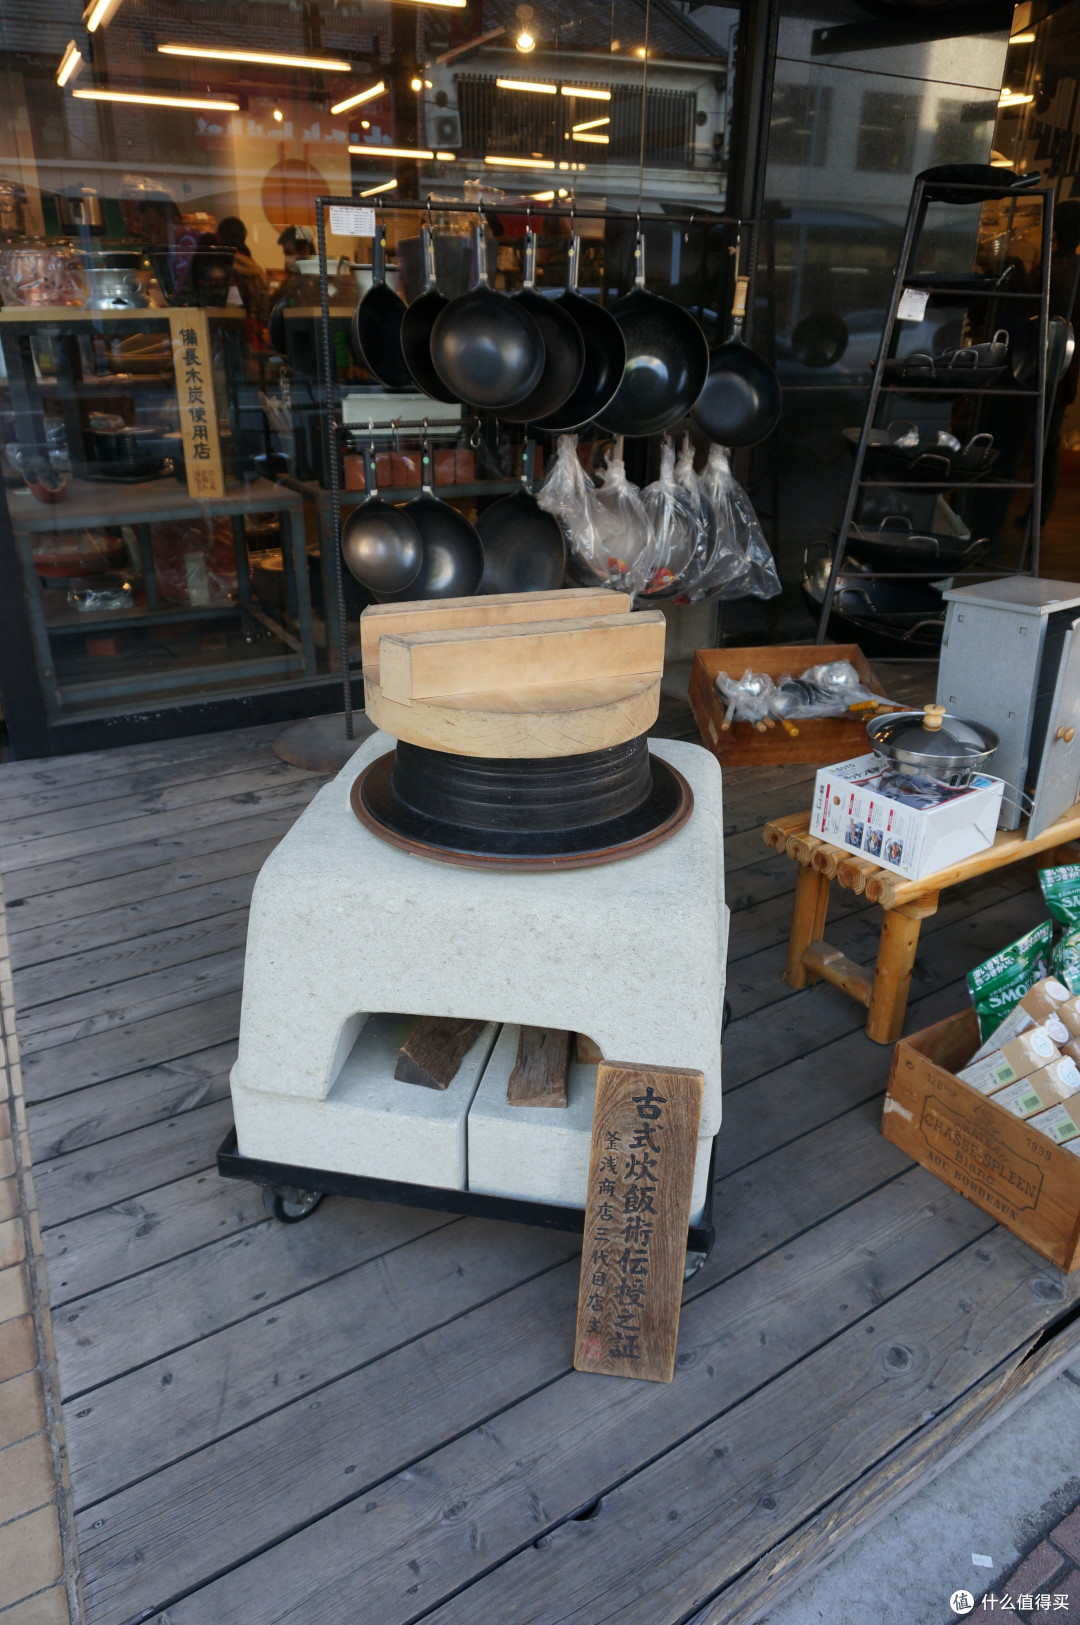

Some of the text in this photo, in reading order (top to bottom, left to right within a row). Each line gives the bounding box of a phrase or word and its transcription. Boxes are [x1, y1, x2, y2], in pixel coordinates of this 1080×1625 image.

[179, 328, 210, 460] 備長木炭使用店
[924, 1113, 1036, 1199] CHASSE-SPLEEN
[926, 1151, 1019, 1221] AOC BORDEAUX
[955, 1150, 995, 1185] Blanc
[1026, 1137, 1052, 1161] 1999
[586, 1131, 621, 1333] 釜浅商店三代目店主
[609, 1086, 667, 1359] 古式炊飯術伝授之証
